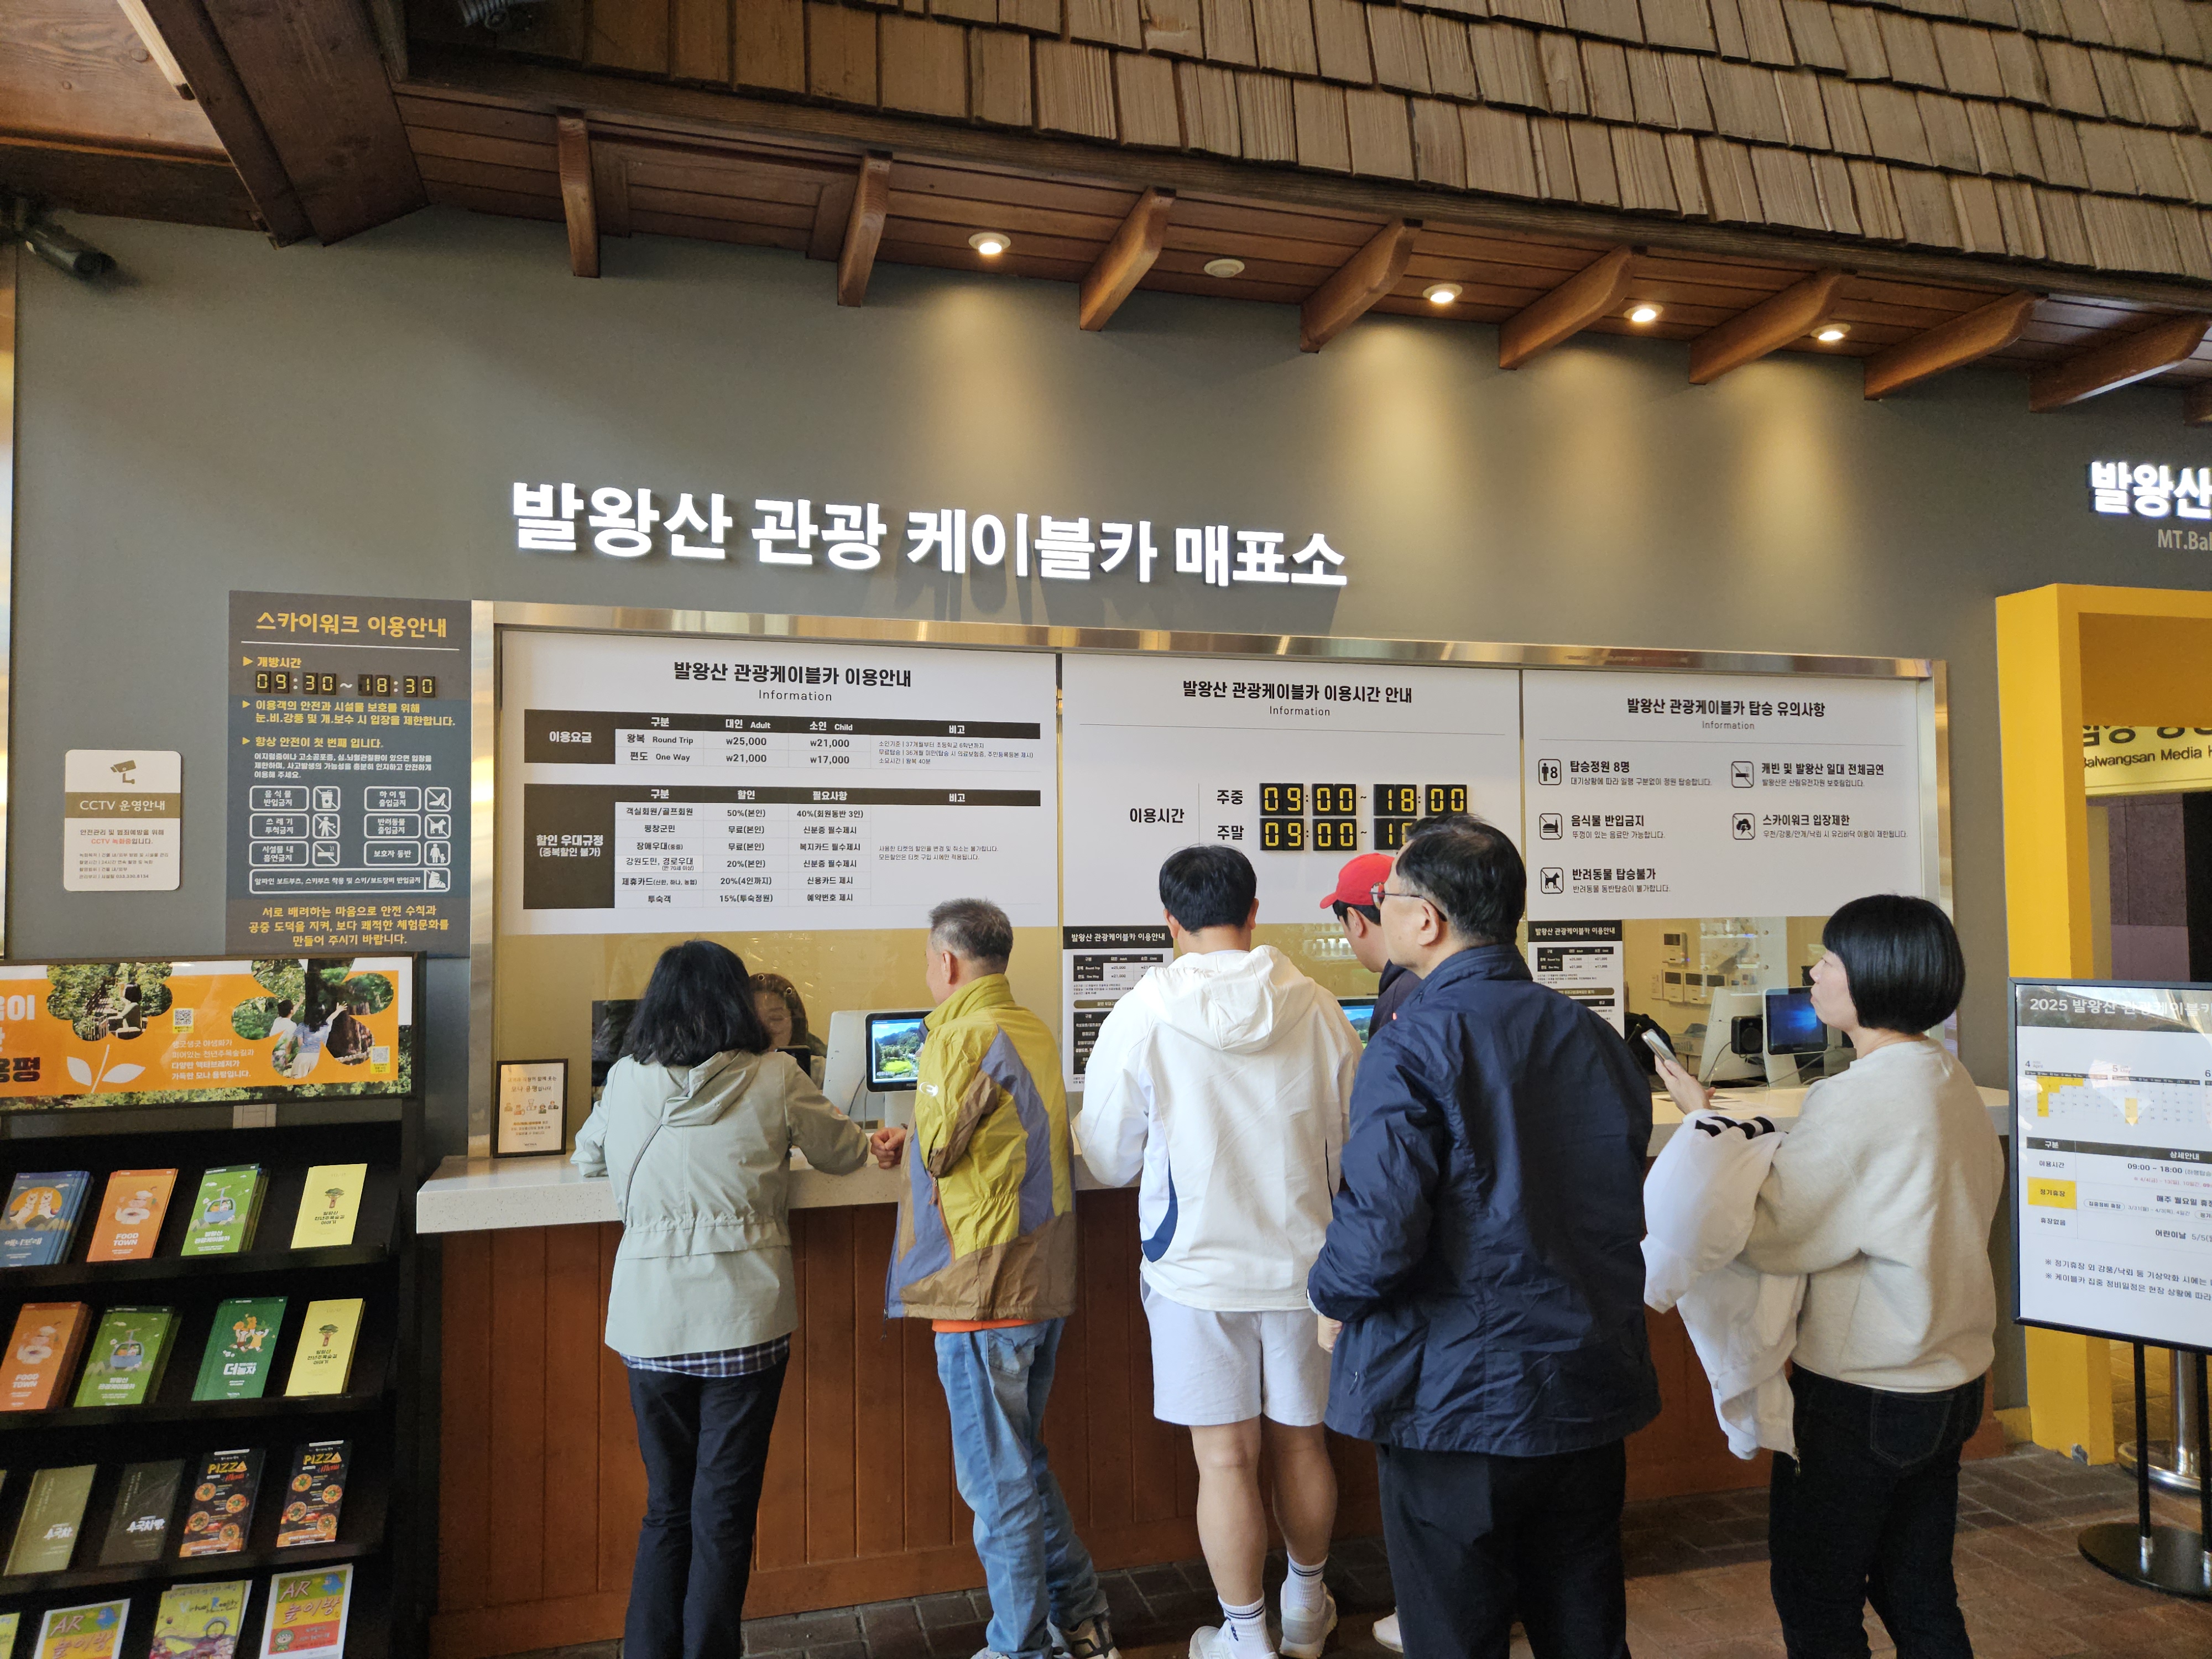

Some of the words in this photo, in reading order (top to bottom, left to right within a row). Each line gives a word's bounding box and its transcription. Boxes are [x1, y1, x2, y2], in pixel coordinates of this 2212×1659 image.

[2091, 461, 2212, 518] 발왕산
[514, 483, 732, 559] 발왕산
[752, 499, 886, 570] 관광
[907, 509, 1157, 582] 케이블카
[1176, 525, 1347, 586] 매표소
[256, 612, 359, 634] 스카이워크
[368, 617, 446, 638] 이용안내
[258, 657, 301, 668] 개방시간
[675, 662, 728, 681] 발왕산
[734, 664, 839, 684] 관광케이블카
[846, 669, 910, 687] 이용안내
[760, 690, 831, 701] Information
[1183, 681, 1227, 697] 발왕산
[1233, 682, 1319, 700] 관광케이블카
[1325, 685, 1380, 702] 이용시간
[1386, 687, 1411, 703] 안내
[256, 700, 296, 710] 이용객의
[301, 701, 331, 711] 안전과
[335, 702, 364, 712] 시설물
[368, 703, 397, 713] 보호를
[401, 703, 420, 713] 위해
[1270, 706, 1329, 716] Information
[1628, 698, 1665, 713] 발왕산
[1670, 700, 1745, 715] 관광케이블카
[1750, 701, 1772, 716] 탑승
[1778, 702, 1825, 717] 유의사항
[307, 714, 316, 723] 및
[321, 714, 354, 724] 개.보수
[357, 715, 367, 724] 시
[371, 715, 400, 725] 입장을
[404, 716, 455, 726] 제한합니다.
[651, 717, 669, 727] 구분
[726, 719, 742, 728] 대인
[1703, 721, 1754, 729] Information
[810, 721, 826, 731] 소인
[950, 726, 964, 734] 비고
[256, 737, 276, 747] 항상
[280, 737, 310, 747] 안전이
[314, 738, 323, 747] 첫
[327, 738, 347, 748] 번째
[351, 738, 383, 748] 입니다.
[550, 732, 592, 743] 이용요금
[628, 734, 645, 743] 왕복
[630, 752, 648, 760] 편도
[2161, 747, 2201, 760] Media
[1571, 761, 1609, 773] 탑승정원
[1614, 761, 1629, 773] 8명
[1762, 763, 1780, 774] 캐빈
[1784, 763, 1792, 774] 및
[1796, 764, 1823, 774] 발왕산
[1827, 764, 1844, 774] 일대
[1848, 764, 1884, 775] 전체금연
[651, 789, 669, 799] 구분
[738, 790, 755, 799] 할인
[813, 791, 847, 800] 필요사항
[950, 794, 965, 802] 비고
[1217, 790, 1243, 805] 주중
[80, 801, 116, 810] CCTV
[119, 800, 165, 811] 운영안내
[1130, 808, 1184, 823] 이용시간
[1572, 815, 1600, 826] 음식물
[1605, 815, 1644, 826] 반입금지
[1763, 815, 1809, 825] 스카이워크
[1813, 815, 1849, 826] 입장제한
[1218, 826, 1244, 840] 주말
[536, 834, 557, 846] 할인
[561, 835, 603, 846] 우대규정
[540, 847, 577, 857] (중복할인
[580, 847, 600, 857] 불가)
[1573, 869, 1612, 880] 반려동물
[1616, 869, 1656, 880] 탑승불가
[263, 907, 283, 917] 서로
[288, 906, 331, 917] 배려하는
[336, 906, 377, 917] 마음으로
[381, 906, 401, 916] 안전
[405, 905, 436, 916] 수칙과
[249, 922, 270, 933] 공중
[274, 921, 305, 932] 도덕을
[310, 921, 332, 932] 지켜,
[336, 921, 357, 931] 보다
[361, 920, 393, 931] 쾌적한
[397, 919, 448, 930] 체험문화를
[293, 935, 324, 947] 만들어
[328, 935, 357, 946] 주시기
[363, 934, 407, 945] 바랍니다.
[1072, 933, 1092, 942] 발왕산
[1138, 933, 1165, 941] 이용안내
[2030, 999, 2068, 1011] 2025
[2073, 999, 2117, 1014] 발왕산
[2170, 1151, 2199, 1160] 상세안내
[2175, 1197, 2197, 1206] 월요일
[2156, 1230, 2185, 1239] 어린이날
[279, 1580, 311, 1602] AR
